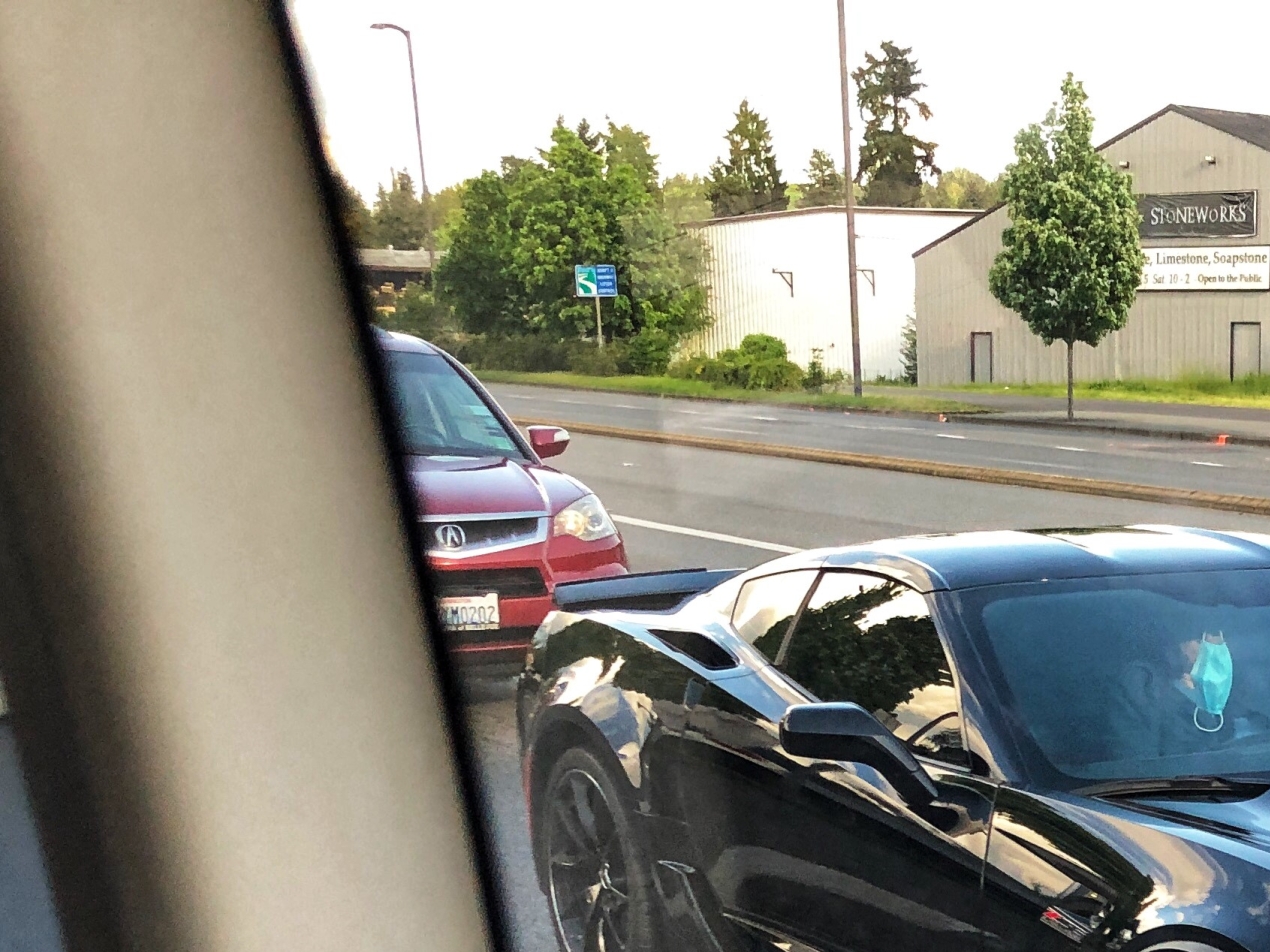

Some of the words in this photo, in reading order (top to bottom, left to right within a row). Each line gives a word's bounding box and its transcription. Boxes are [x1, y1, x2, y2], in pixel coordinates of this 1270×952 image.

[1156, 252, 1211, 266] Limestone,
[1213, 251, 1267, 267] Soapstone
[1152, 274, 1165, 284] Sat
[1169, 274, 1178, 284] 10
[1185, 273, 1190, 284] 2
[1197, 273, 1217, 286] Open
[1218, 275, 1225, 283] to
[1226, 273, 1237, 282] the
[1239, 273, 1262, 283] Public
